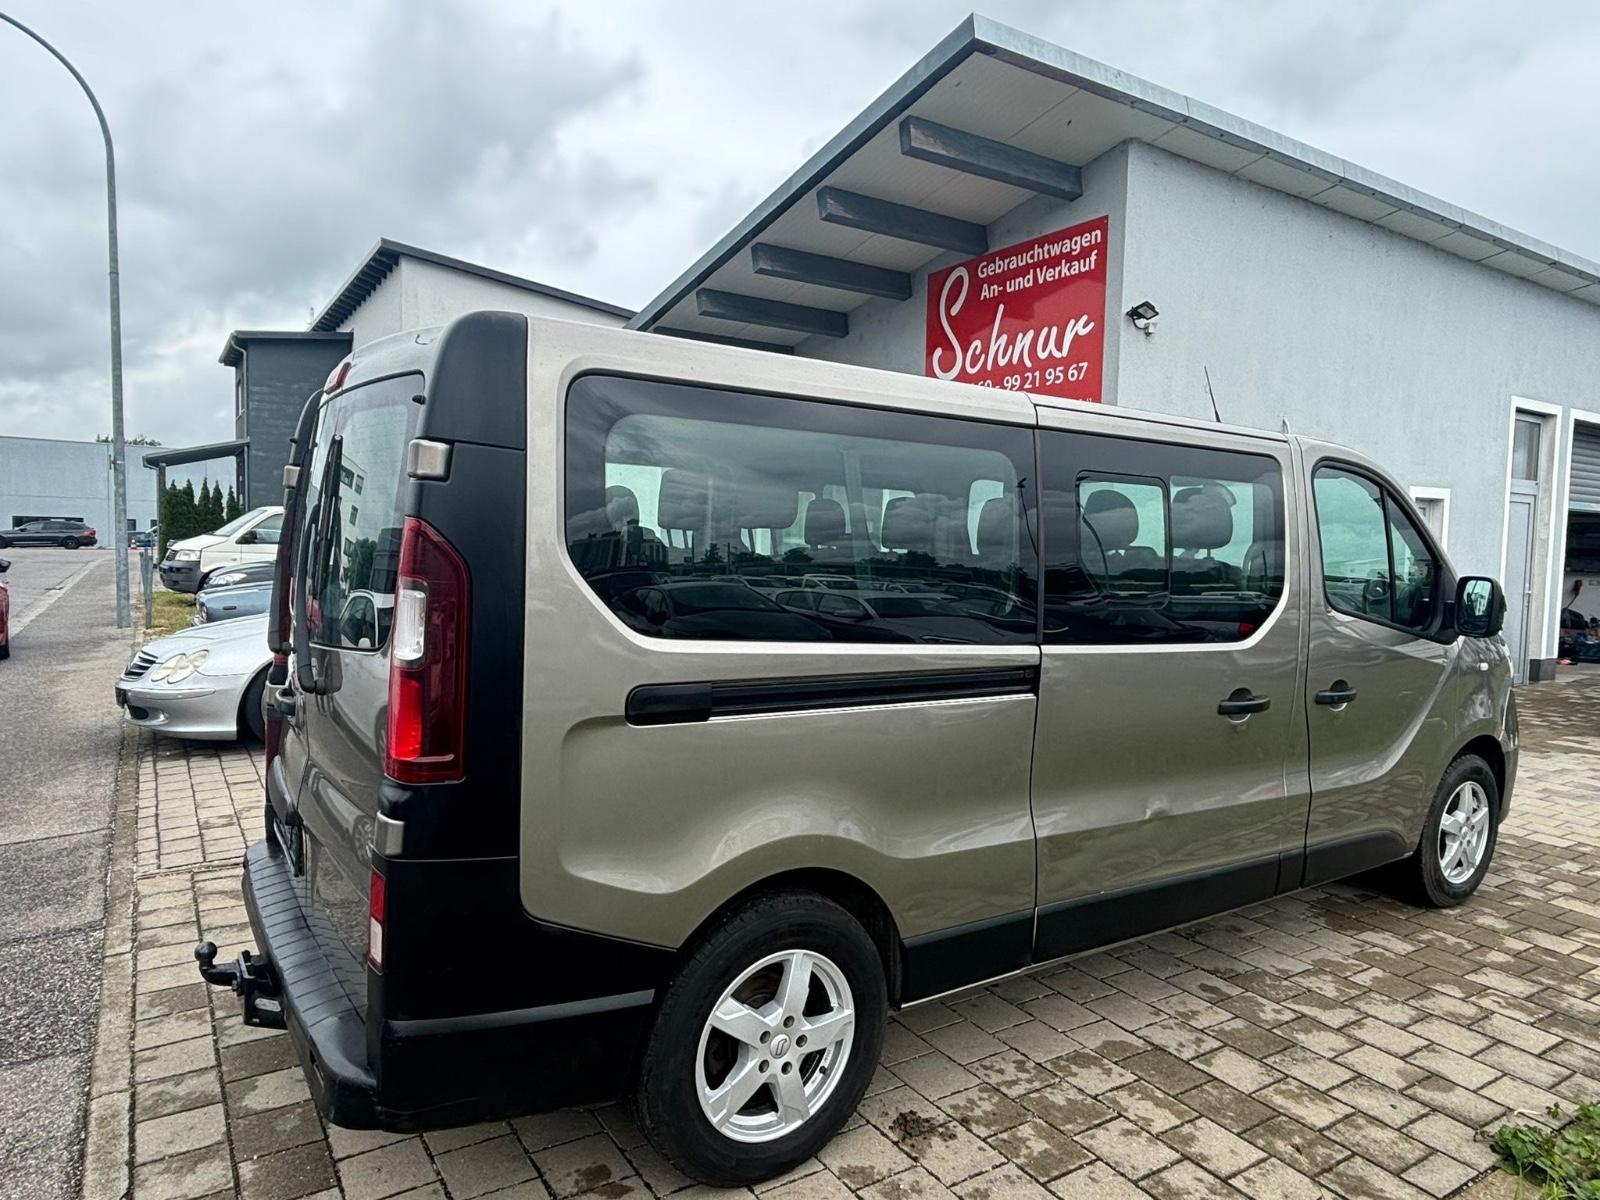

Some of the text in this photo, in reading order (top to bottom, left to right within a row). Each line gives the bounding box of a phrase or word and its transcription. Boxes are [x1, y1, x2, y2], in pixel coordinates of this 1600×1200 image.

[977, 229, 1102, 279] Gebrauchtwagen
[980, 250, 1098, 300] An- und Verkauf
[932, 266, 1095, 380] Schnur
[1003, 374, 1021, 391] 99
[1024, 371, 1040, 389] 21
[1045, 367, 1064, 386] 95
[1067, 361, 1088, 381] 67
